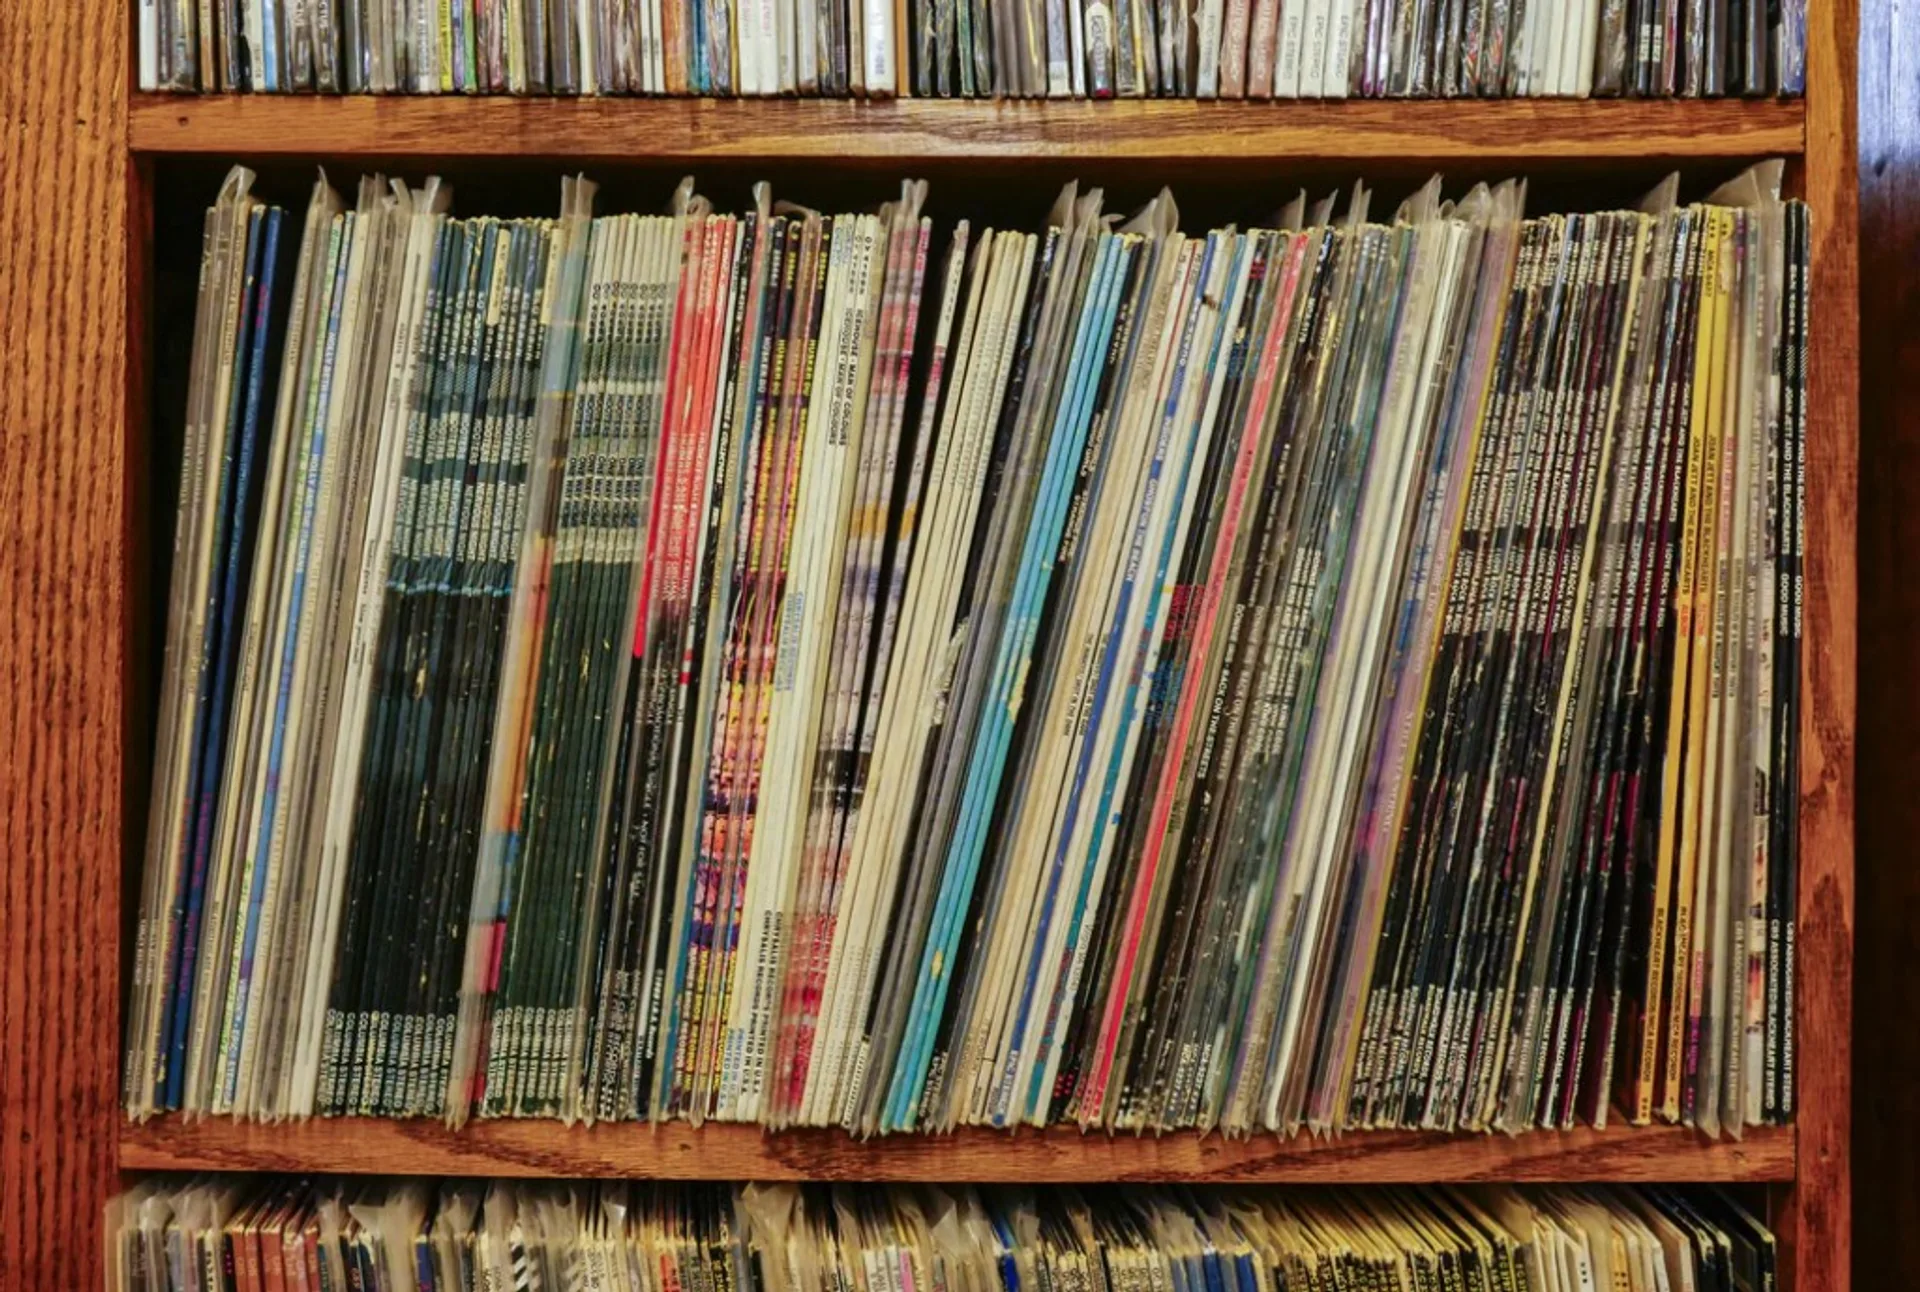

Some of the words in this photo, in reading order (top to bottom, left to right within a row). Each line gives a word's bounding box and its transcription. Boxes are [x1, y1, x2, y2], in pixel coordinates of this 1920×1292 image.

[325, 332, 336, 359] HOLLY
[850, 309, 862, 355] ICEHOUSE
[835, 362, 845, 383] MAN
[846, 363, 855, 384] MAN
[833, 386, 842, 398] OF
[844, 387, 852, 399] OF
[1598, 386, 1609, 409] JOAN
[1783, 387, 1792, 412] JOAN
[583, 394, 595, 437] HOOTERS
[602, 393, 614, 437] HOOTERS
[612, 394, 624, 438] HOOTERS
[838, 401, 850, 446] COLOURS
[1595, 411, 1605, 428] JETT
[1783, 415, 1792, 439] JETT
[490, 416, 503, 463] HOOTERS
[501, 413, 514, 460] HOOTERS
[511, 418, 524, 465] HOOTERS
[1154, 415, 1172, 460] INSIDERS
[1591, 430, 1601, 447] AND
[1691, 436, 1701, 458] JOAN
[1783, 441, 1792, 461] AND
[307, 453, 318, 483] HOLLY
[577, 456, 587, 476] ONE
[596, 455, 606, 475] ONE
[607, 455, 616, 475] ONE
[1588, 449, 1598, 465] THE
[1689, 461, 1699, 483] JETT
[1783, 463, 1792, 481] THE
[303, 487, 314, 507] AND
[493, 480, 506, 527] NERVOUS
[574, 480, 583, 497] WAY
[593, 479, 602, 497] WAY
[604, 480, 613, 498] WAY
[1578, 467, 1594, 524] BLACKHEARTS
[1687, 488, 1697, 507] AND
[482, 482, 494, 529] NERVOUS
[503, 485, 515, 531] NERVOUS
[1686, 509, 1696, 525] THE
[1782, 484, 1792, 554] BLACKHEARTS
[477, 532, 488, 561] NIGHT
[489, 529, 499, 559] NIGHT
[498, 534, 509, 563] NIGHT
[1133, 526, 1145, 545] THE
[1125, 547, 1141, 582] BEACH
[1307, 550, 1322, 585] DONNIE
[1570, 549, 1580, 570] LOVE
[1681, 528, 1694, 594] BLACKHEARTS
[1302, 587, 1314, 607] IRIS
[1565, 573, 1576, 596] ROCK
[1779, 572, 1789, 602] GOOD
[1227, 603, 1244, 641] DONNIE
[1298, 608, 1310, 628] AND
[1560, 608, 1570, 628] ROLL
[1678, 604, 1689, 636] ALBUM
[1778, 604, 1789, 635] MUSIC
[1294, 630, 1305, 648] THE
[1215, 668, 1229, 696] BACK
[1282, 650, 1301, 697] CRUISERS
[1211, 697, 1223, 713] ON
[1276, 703, 1289, 727] KING
[1196, 734, 1214, 779] STREETS
[1270, 728, 1284, 755] COOL
[758, 910, 771, 963] CHRYSALIS
[769, 911, 782, 965] CHRYSALIS
[1652, 907, 1664, 967] BLACKHEART
[1769, 919, 1779, 938] CBS
[751, 965, 764, 1010] RECORDS
[341, 1012, 355, 1064] COLUMBIA
[354, 1011, 368, 1063] COLUMBIA
[375, 1012, 389, 1064] COLUMBIA
[399, 1014, 413, 1067] COLUMBIA
[410, 1016, 424, 1069] COLUMBIA
[542, 1009, 555, 1057] COLUMBIA
[552, 1008, 565, 1057] COLUMBIA
[644, 1025, 655, 1058] Records
[745, 1012, 757, 1053] PRINTED
[757, 1013, 769, 1054] PRINTED
[743, 1055, 752, 1066] IN
[754, 1056, 763, 1067] IN
[1642, 1039, 1653, 1081] RECORDS
[335, 1065, 347, 1104] STEREO
[348, 1065, 361, 1104] STEREO
[369, 1066, 382, 1105] STEREO
[393, 1068, 406, 1107] STEREO
[404, 1070, 417, 1108] STEREO
[537, 1061, 548, 1098] STEREO
[547, 1061, 559, 1099] STEREO
